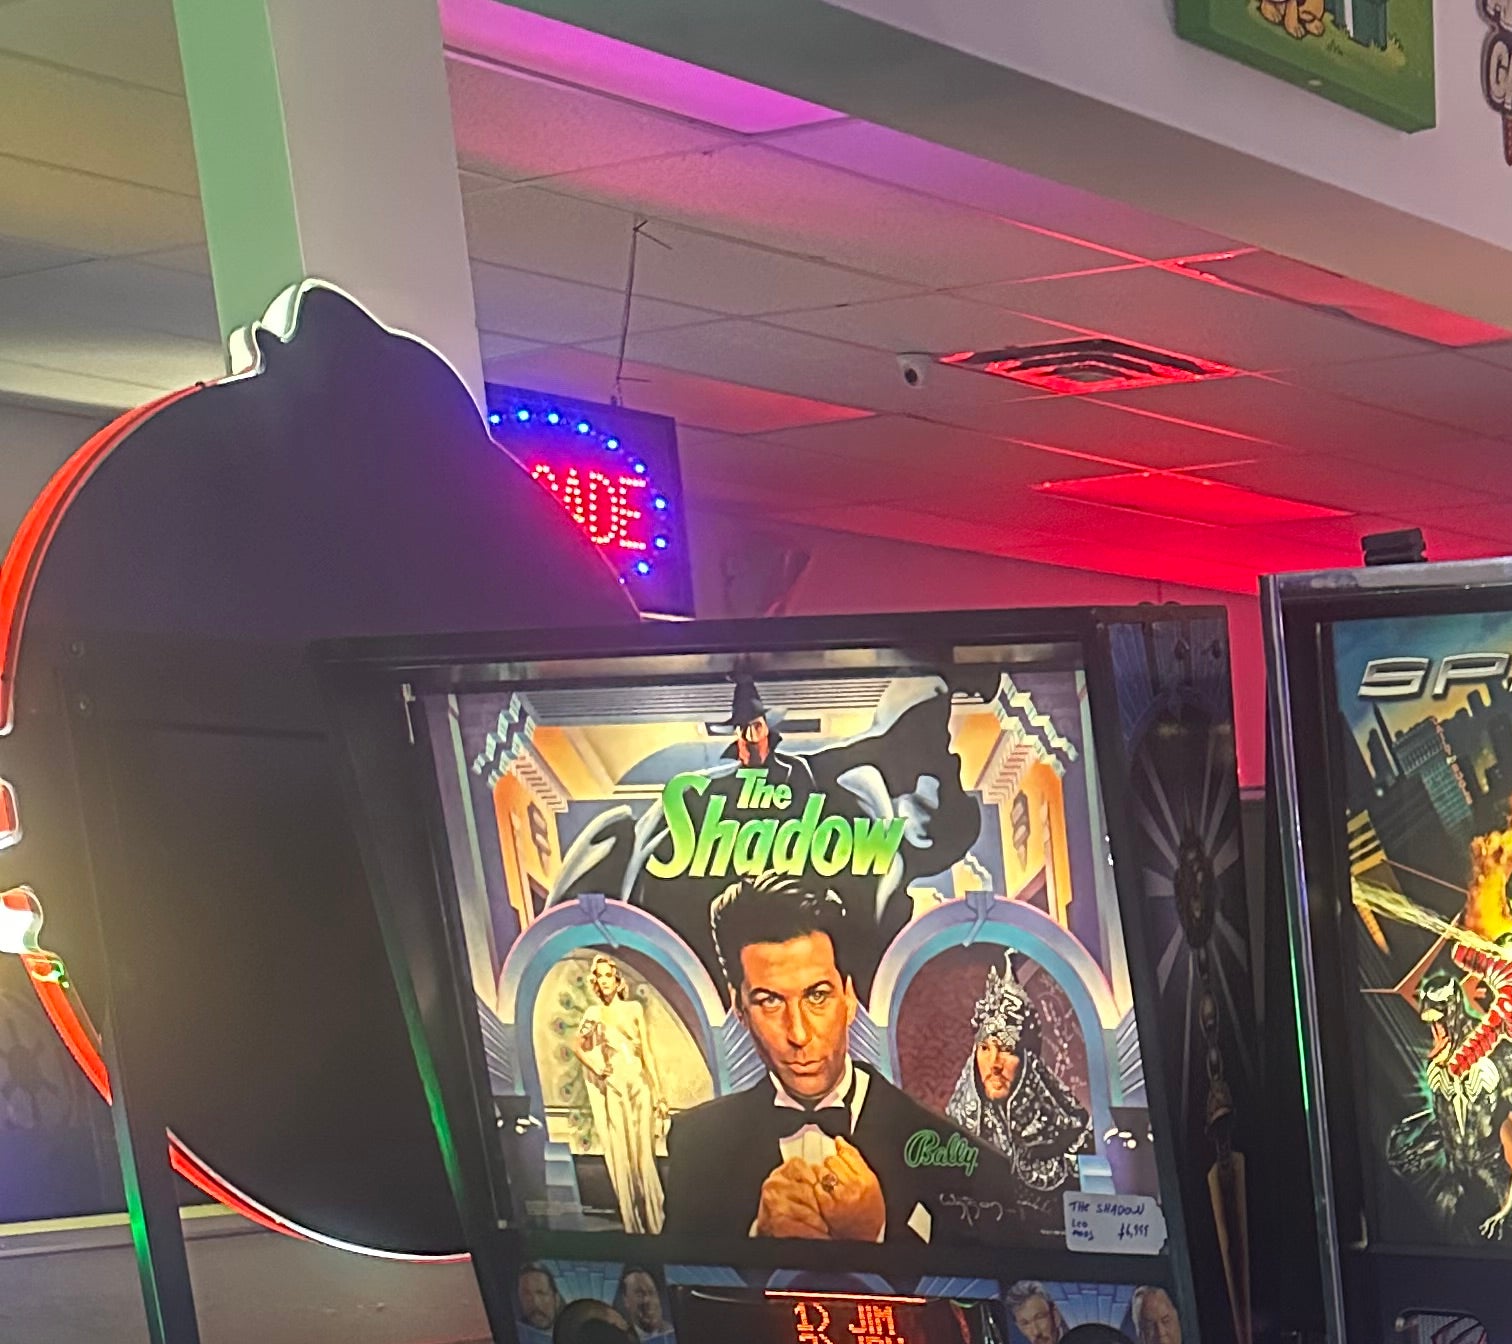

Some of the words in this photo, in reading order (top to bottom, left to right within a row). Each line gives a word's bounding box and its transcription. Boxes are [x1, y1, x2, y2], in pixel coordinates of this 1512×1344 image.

[735, 768, 793, 809] The
[645, 771, 908, 879] Shadow
[904, 1129, 979, 1177] Bally
[849, 1304, 897, 1336] JIM
